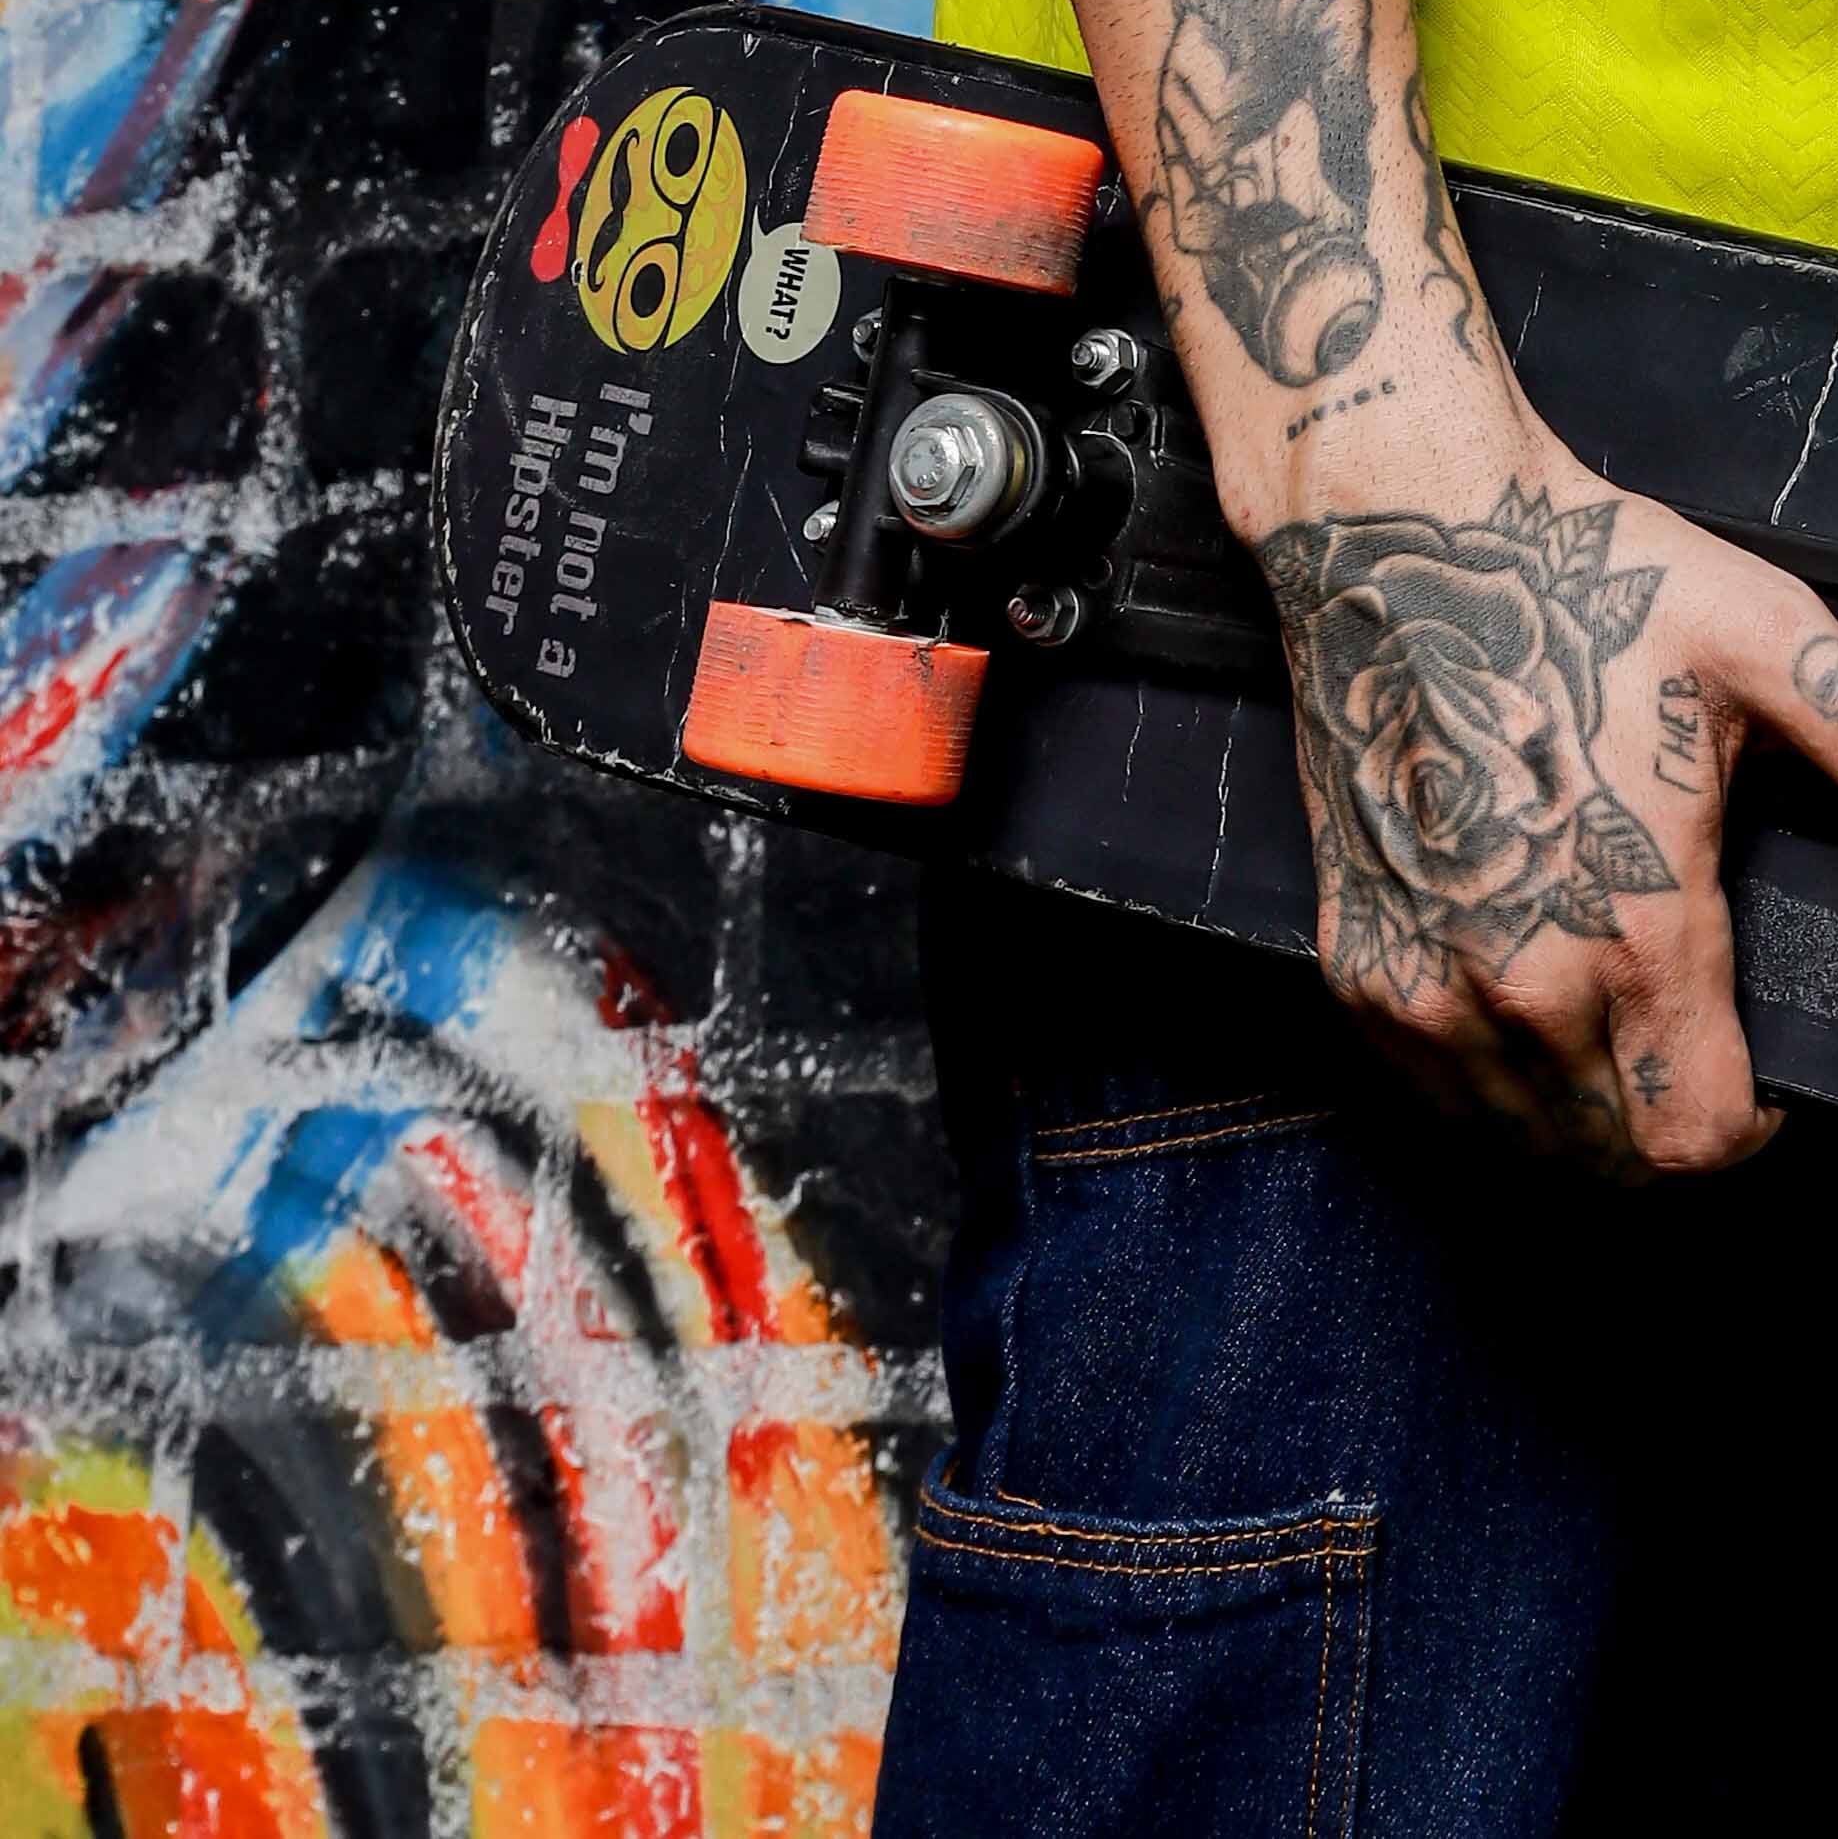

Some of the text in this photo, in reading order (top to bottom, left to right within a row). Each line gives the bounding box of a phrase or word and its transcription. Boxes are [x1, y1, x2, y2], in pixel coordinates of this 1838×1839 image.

[766, 248, 809, 341] WHAT?
[486, 394, 578, 635] Hipster
[536, 384, 653, 679] I'm not a
